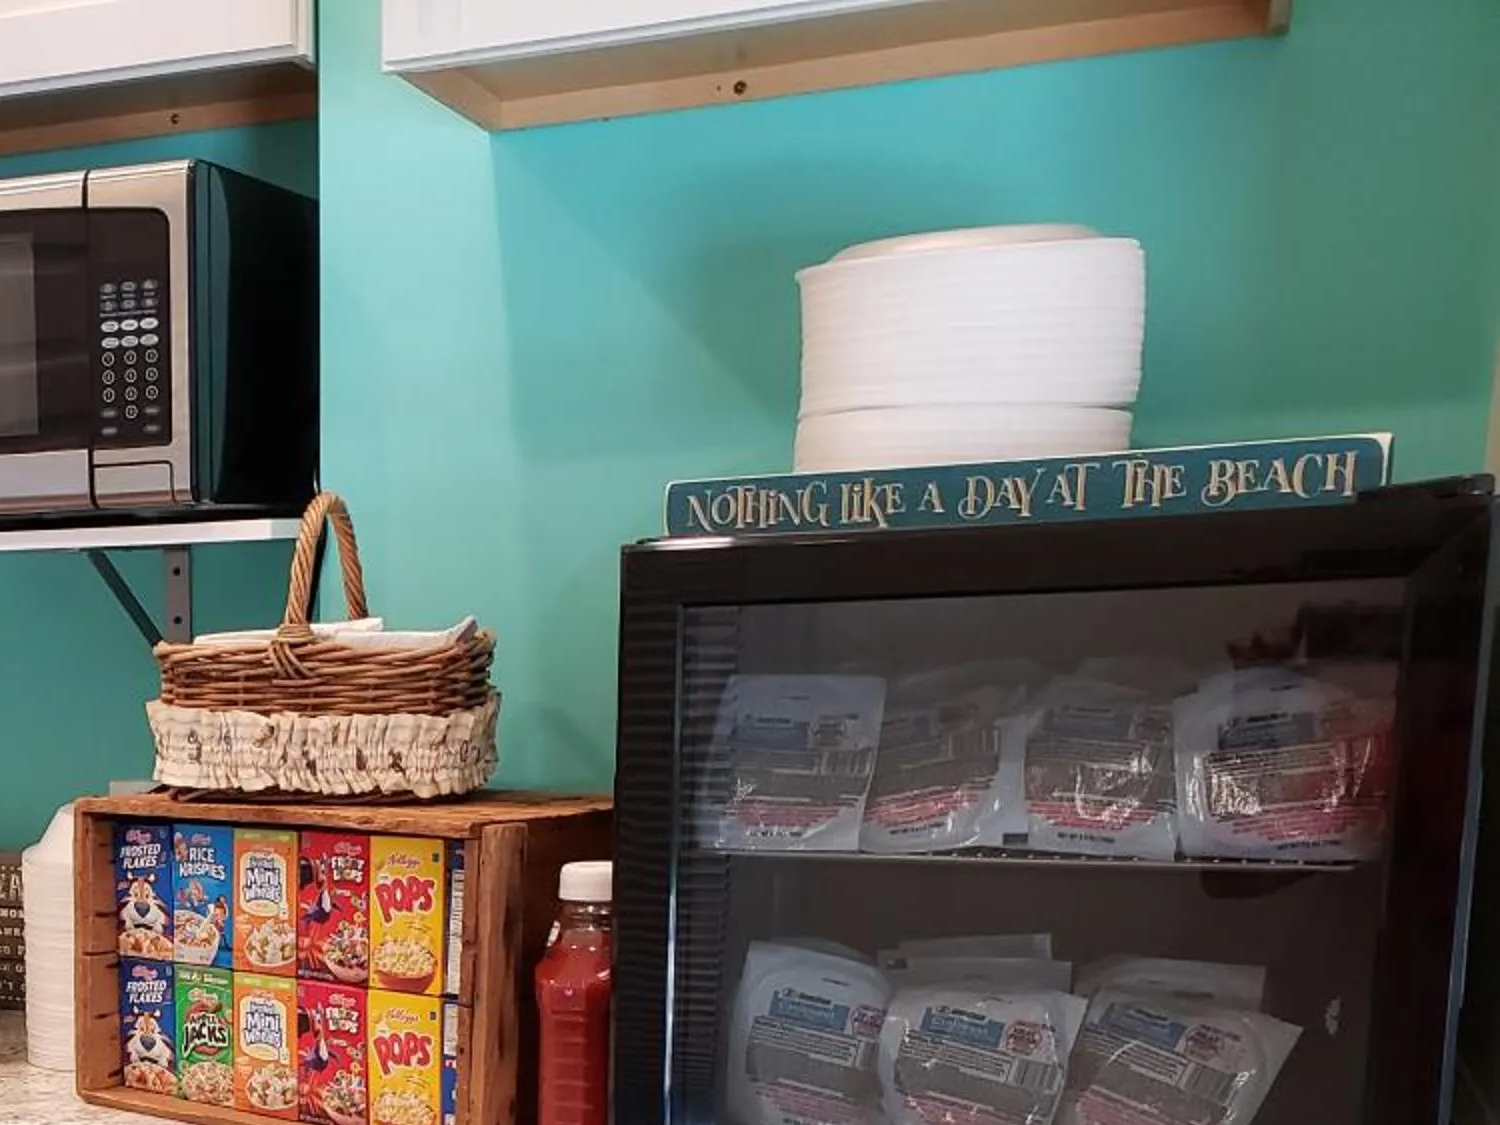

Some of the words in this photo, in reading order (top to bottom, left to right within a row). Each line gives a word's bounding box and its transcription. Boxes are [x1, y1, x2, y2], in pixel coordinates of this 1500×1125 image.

[917, 480, 946, 513] A
[958, 467, 1044, 519] DAY
[1047, 463, 1100, 510] AT
[1112, 455, 1187, 508] THE
[1201, 451, 1360, 507] BEACH
[120, 843, 161, 858] FROSTED
[189, 847, 215, 863] RICE
[123, 856, 157, 869] FLAKES
[179, 862, 226, 880] KRISPIES
[245, 868, 280, 886] Mini
[374, 875, 435, 924] POPS
[126, 981, 167, 994] FROSTED
[129, 991, 164, 1004] FLAKES
[246, 1012, 280, 1030] Mini
[182, 1022, 228, 1056] JACKS
[373, 1031, 432, 1075] POPS
